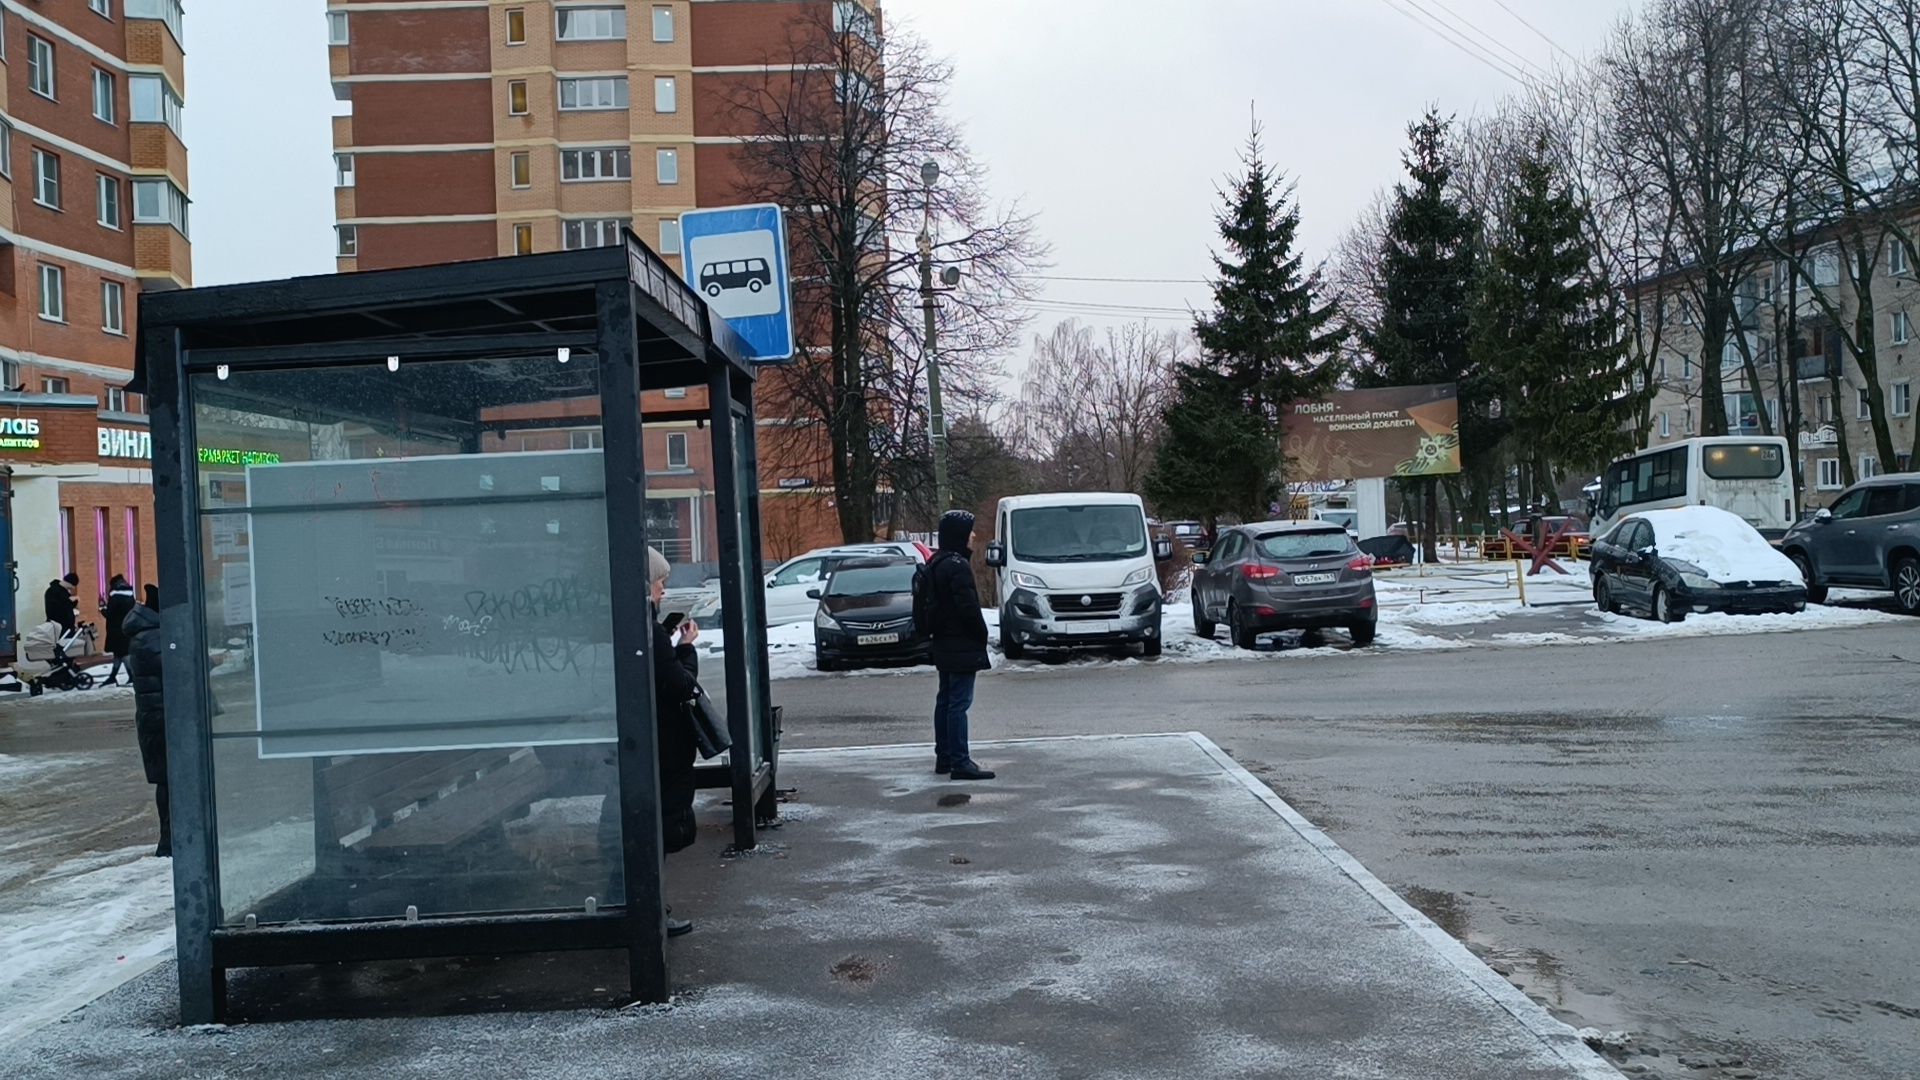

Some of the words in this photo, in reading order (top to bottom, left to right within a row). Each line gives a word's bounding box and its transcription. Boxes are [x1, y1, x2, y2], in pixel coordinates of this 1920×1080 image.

[1294, 402, 1334, 415] ЛОБНЯ
[1313, 411, 1371, 423] НАСЕЛЕННЫЙ
[1372, 410, 1400, 419] ПУНКТ
[1328, 420, 1372, 432] ВОИНСКОЙ
[1373, 418, 1416, 430] ДОБЛЕСТИ
